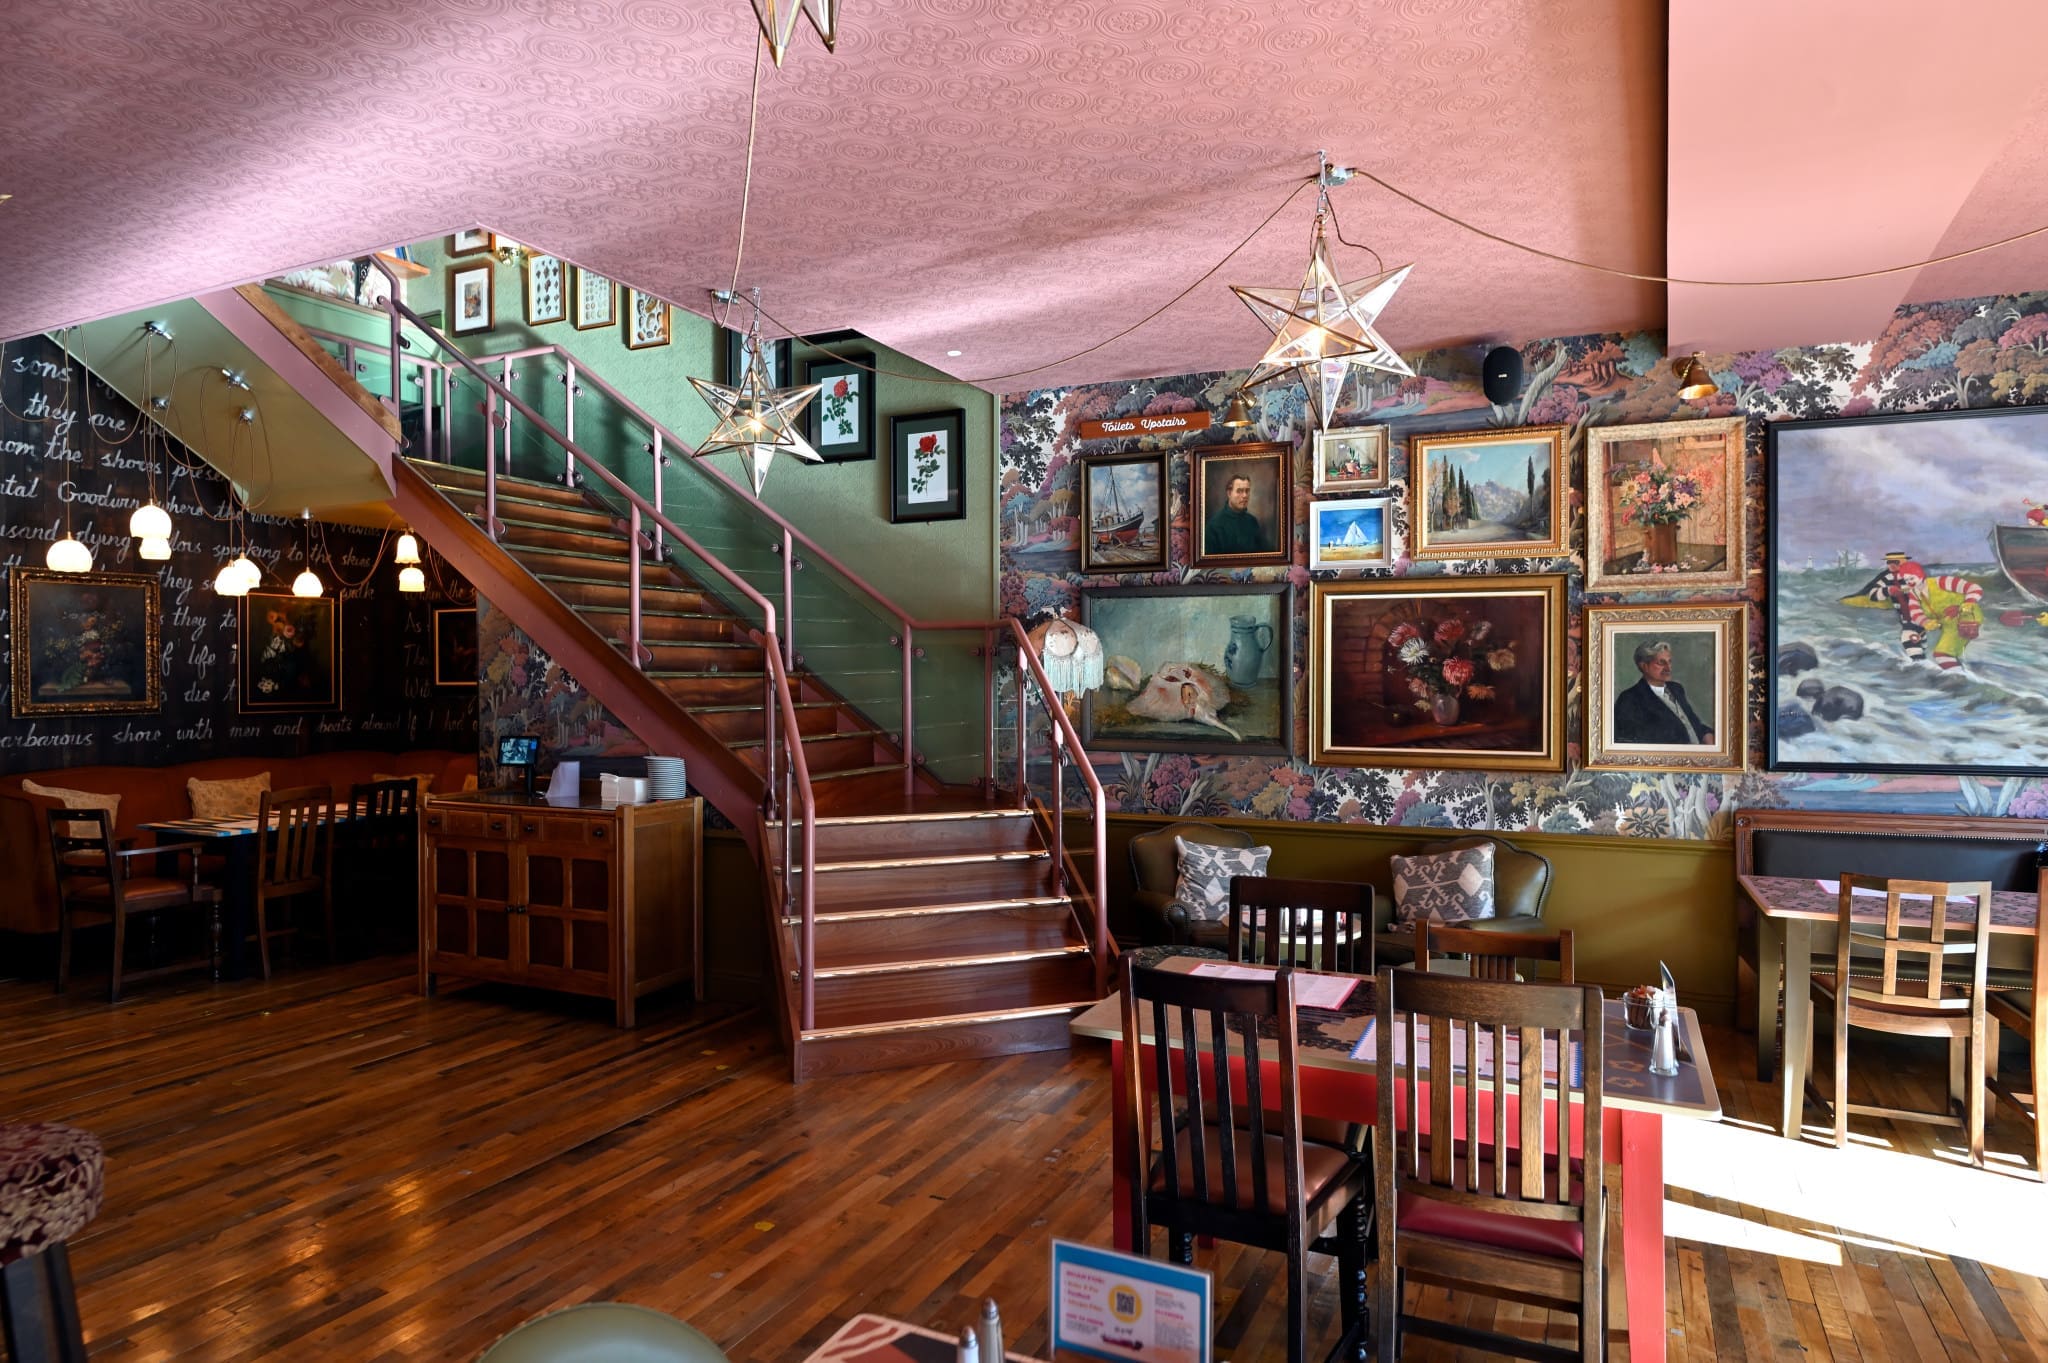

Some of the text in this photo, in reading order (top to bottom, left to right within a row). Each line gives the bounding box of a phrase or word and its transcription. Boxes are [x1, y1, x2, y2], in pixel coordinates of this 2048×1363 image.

[12, 357, 72, 382] sons
[24, 392, 78, 436] they
[88, 413, 126, 432] are
[1102, 417, 1187, 432] Toilets Upstairs
[44, 435, 83, 462] the
[101, 449, 161, 475] shores
[58, 481, 140, 509] Goodwin
[76, 521, 131, 564] dying
[288, 541, 303, 561] to
[310, 543, 333, 564] the
[157, 565, 193, 605] they
[172, 606, 207, 641] they
[188, 643, 216, 680] life
[184, 681, 211, 702] die
[0, 723, 93, 748] arbarous
[113, 722, 162, 742] shore
[176, 717, 213, 741] with
[273, 716, 303, 736] and
